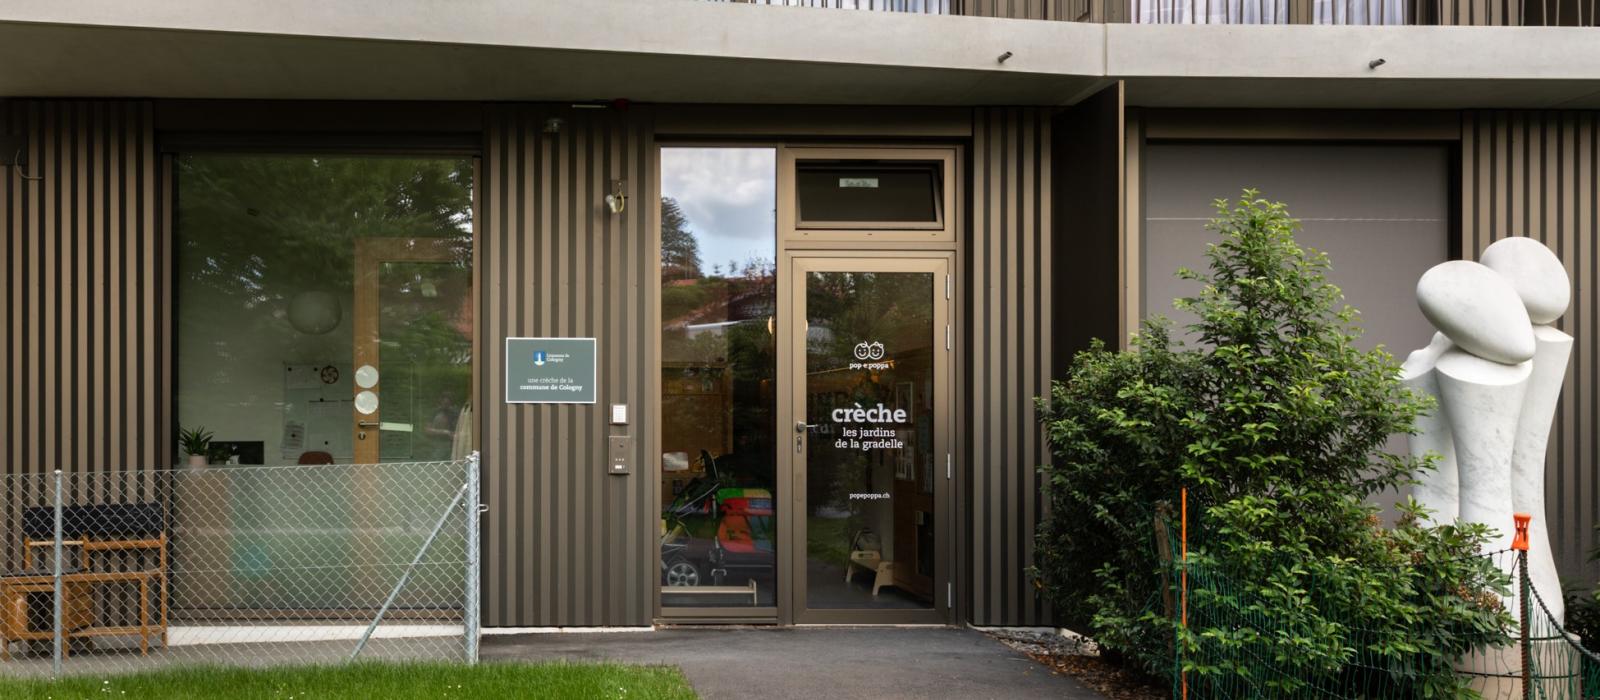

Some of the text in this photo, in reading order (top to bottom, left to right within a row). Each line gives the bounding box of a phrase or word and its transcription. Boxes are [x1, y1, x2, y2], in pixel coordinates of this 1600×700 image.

[849, 363, 862, 371] pop
[868, 363, 889, 371] poppa
[559, 384, 583, 392] Cologny
[832, 402, 907, 423] crèche
[842, 427, 858, 437] les
[859, 427, 896, 440] jardins
[835, 438, 904, 451] de la gradelle
[849, 492, 890, 500] popepoppa.ch
